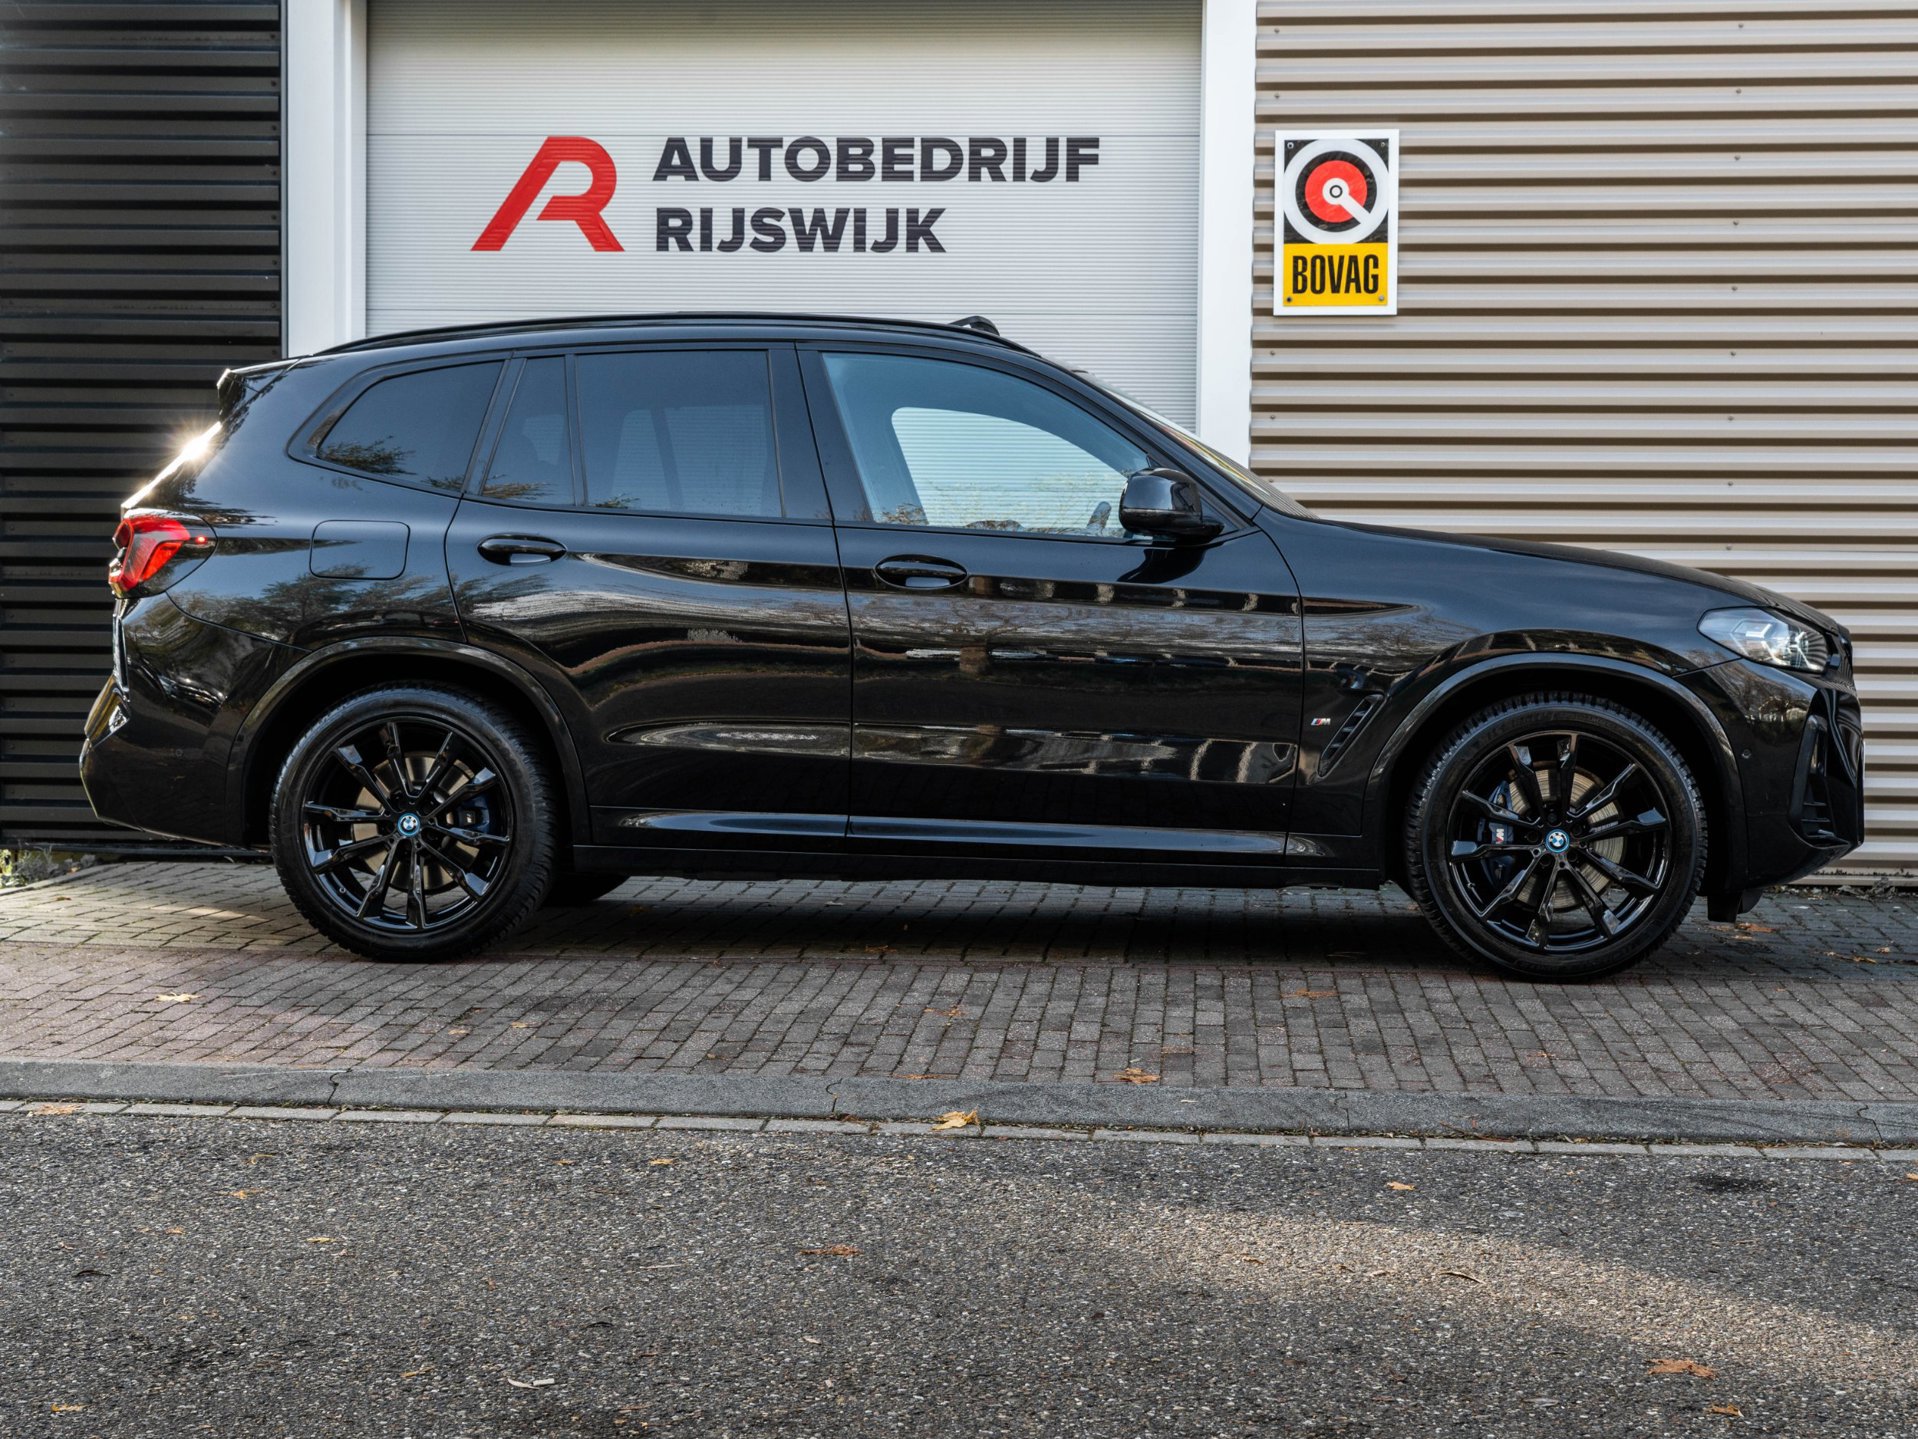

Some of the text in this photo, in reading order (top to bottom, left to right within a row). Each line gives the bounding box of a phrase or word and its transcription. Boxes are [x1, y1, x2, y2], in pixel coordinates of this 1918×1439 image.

[653, 136, 1100, 182] AUTOBEDRIJF
[656, 207, 946, 253] RIJSWIJK
[1292, 254, 1379, 295] BOVAG
